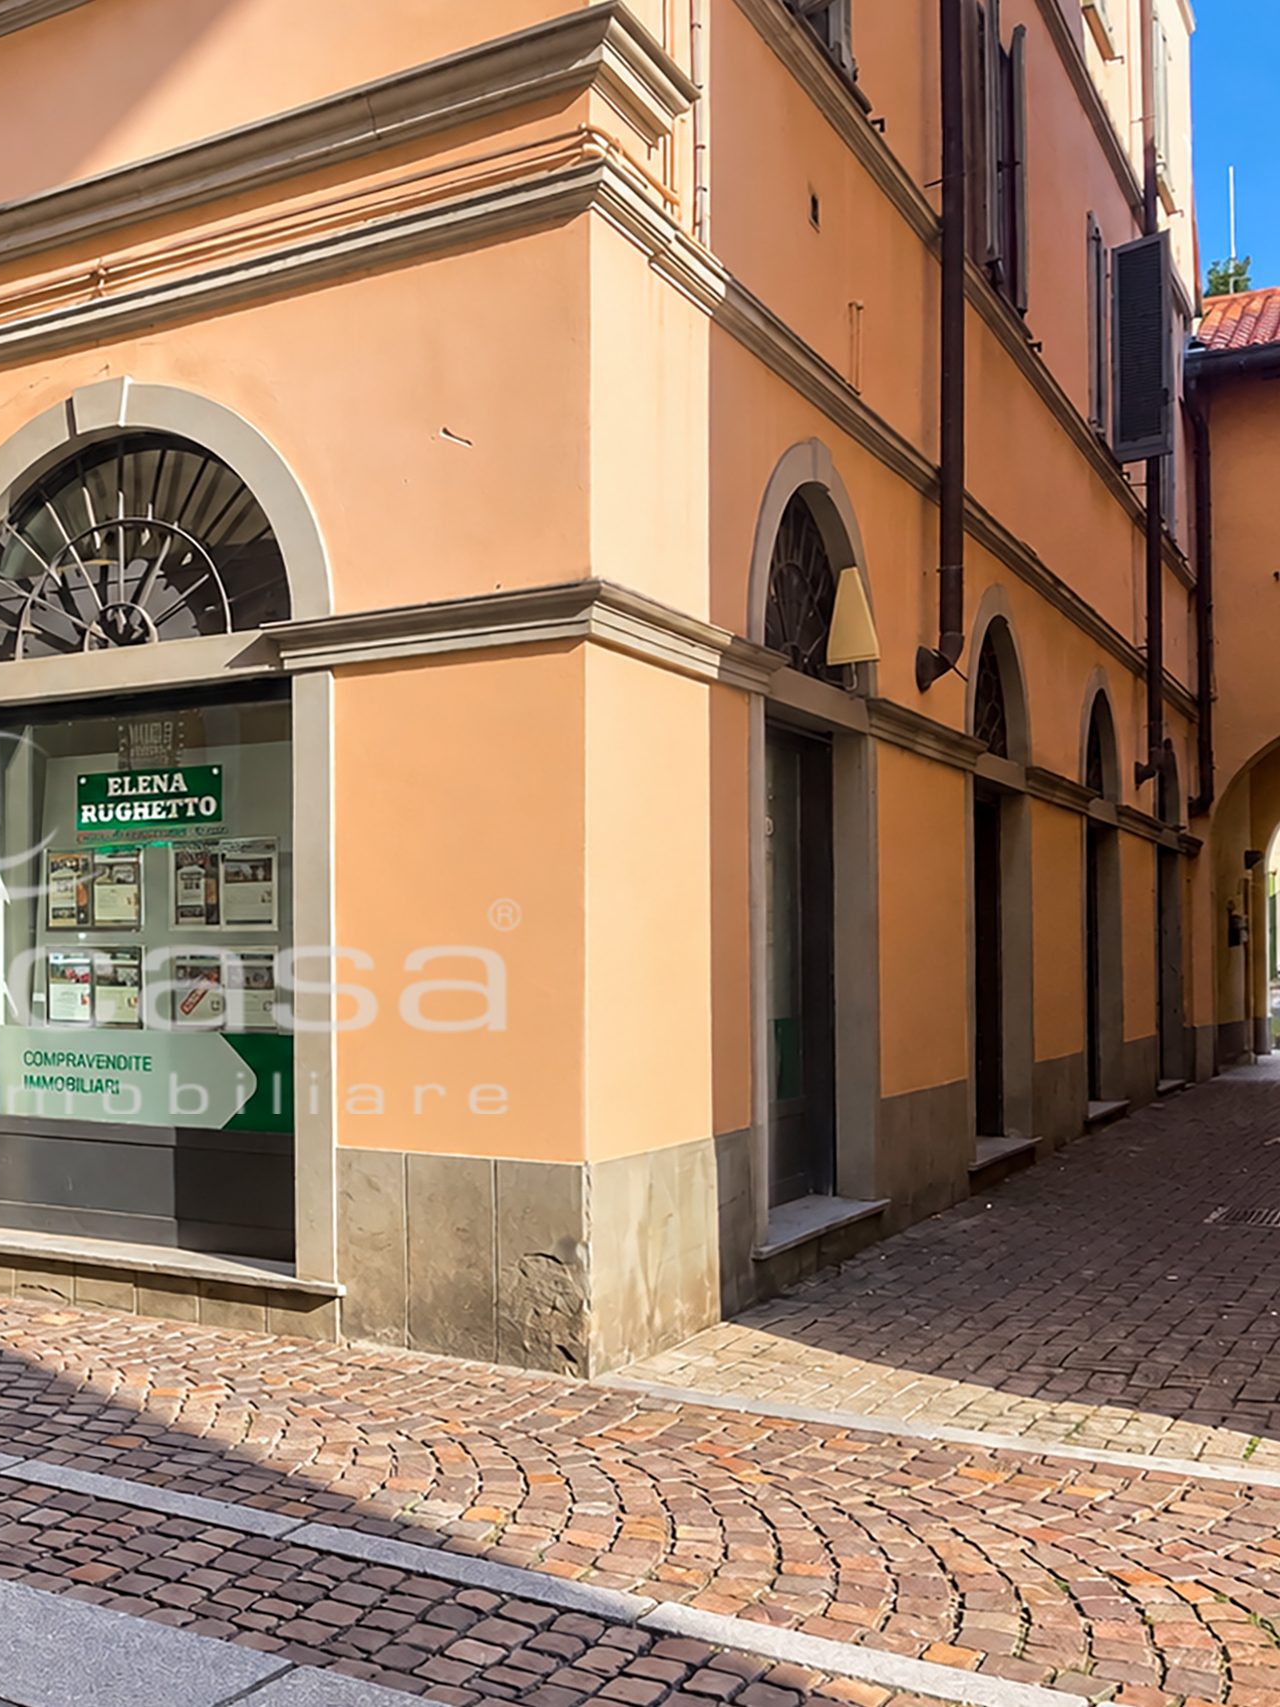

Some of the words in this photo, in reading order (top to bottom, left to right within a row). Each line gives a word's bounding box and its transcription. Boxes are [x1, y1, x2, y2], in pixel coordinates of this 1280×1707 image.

[107, 772, 188, 797] ELENA
[81, 796, 218, 824] RUGHETTO
[23, 1075, 120, 1095] IMMOBILIARI
